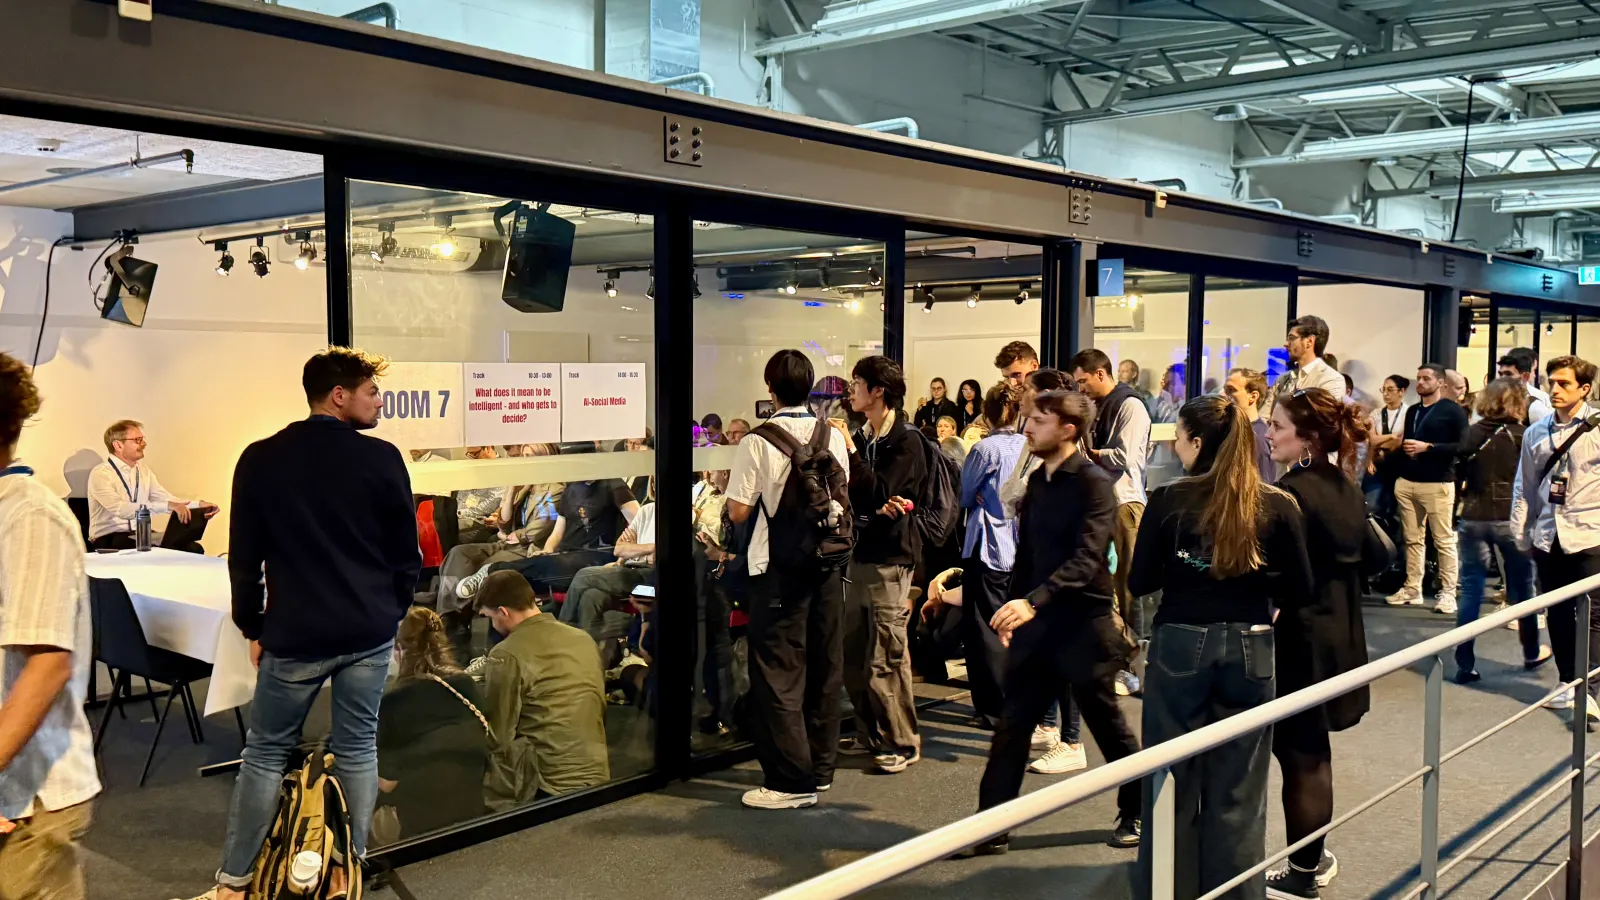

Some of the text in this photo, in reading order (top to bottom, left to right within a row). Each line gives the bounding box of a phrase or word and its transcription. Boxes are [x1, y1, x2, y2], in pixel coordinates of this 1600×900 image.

[1101, 267, 1113, 287] 7
[475, 388, 551, 397] What does it mean to be
[376, 390, 450, 419] OOM 7
[469, 401, 502, 411] intelligent
[508, 401, 520, 410] and
[522, 401, 535, 410] who
[536, 401, 550, 410] gets
[551, 400, 557, 409] to
[610, 396, 626, 406] Media
[502, 414, 528, 424] decide?
